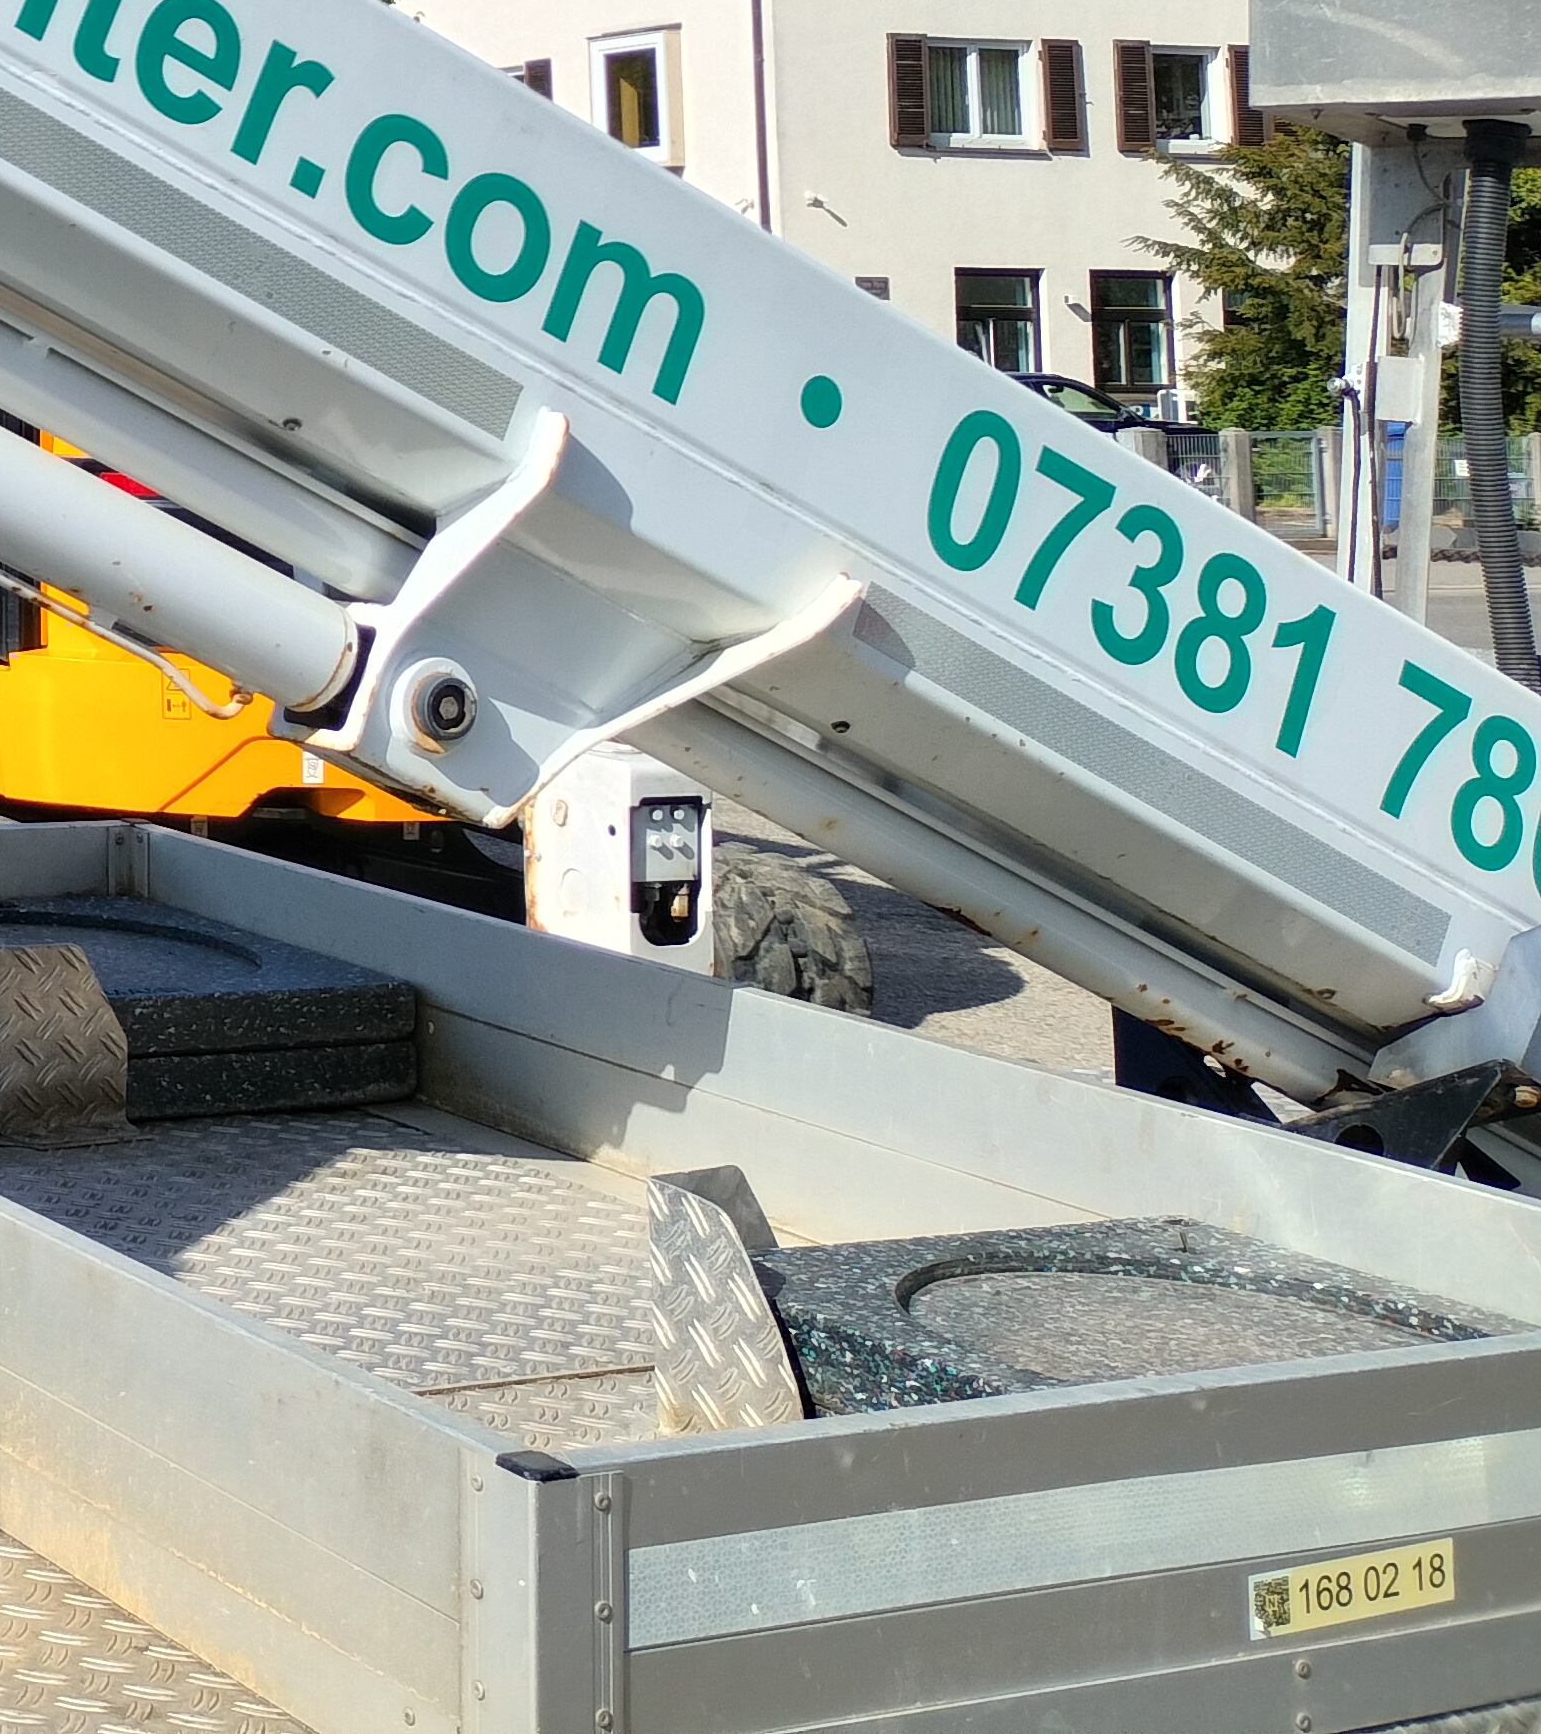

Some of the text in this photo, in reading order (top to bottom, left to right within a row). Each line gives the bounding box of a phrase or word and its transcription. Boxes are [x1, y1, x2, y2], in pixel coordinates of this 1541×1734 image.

[927, 409, 1541, 902] 07381 78
[1299, 1552, 1447, 1615] 168 02 18
